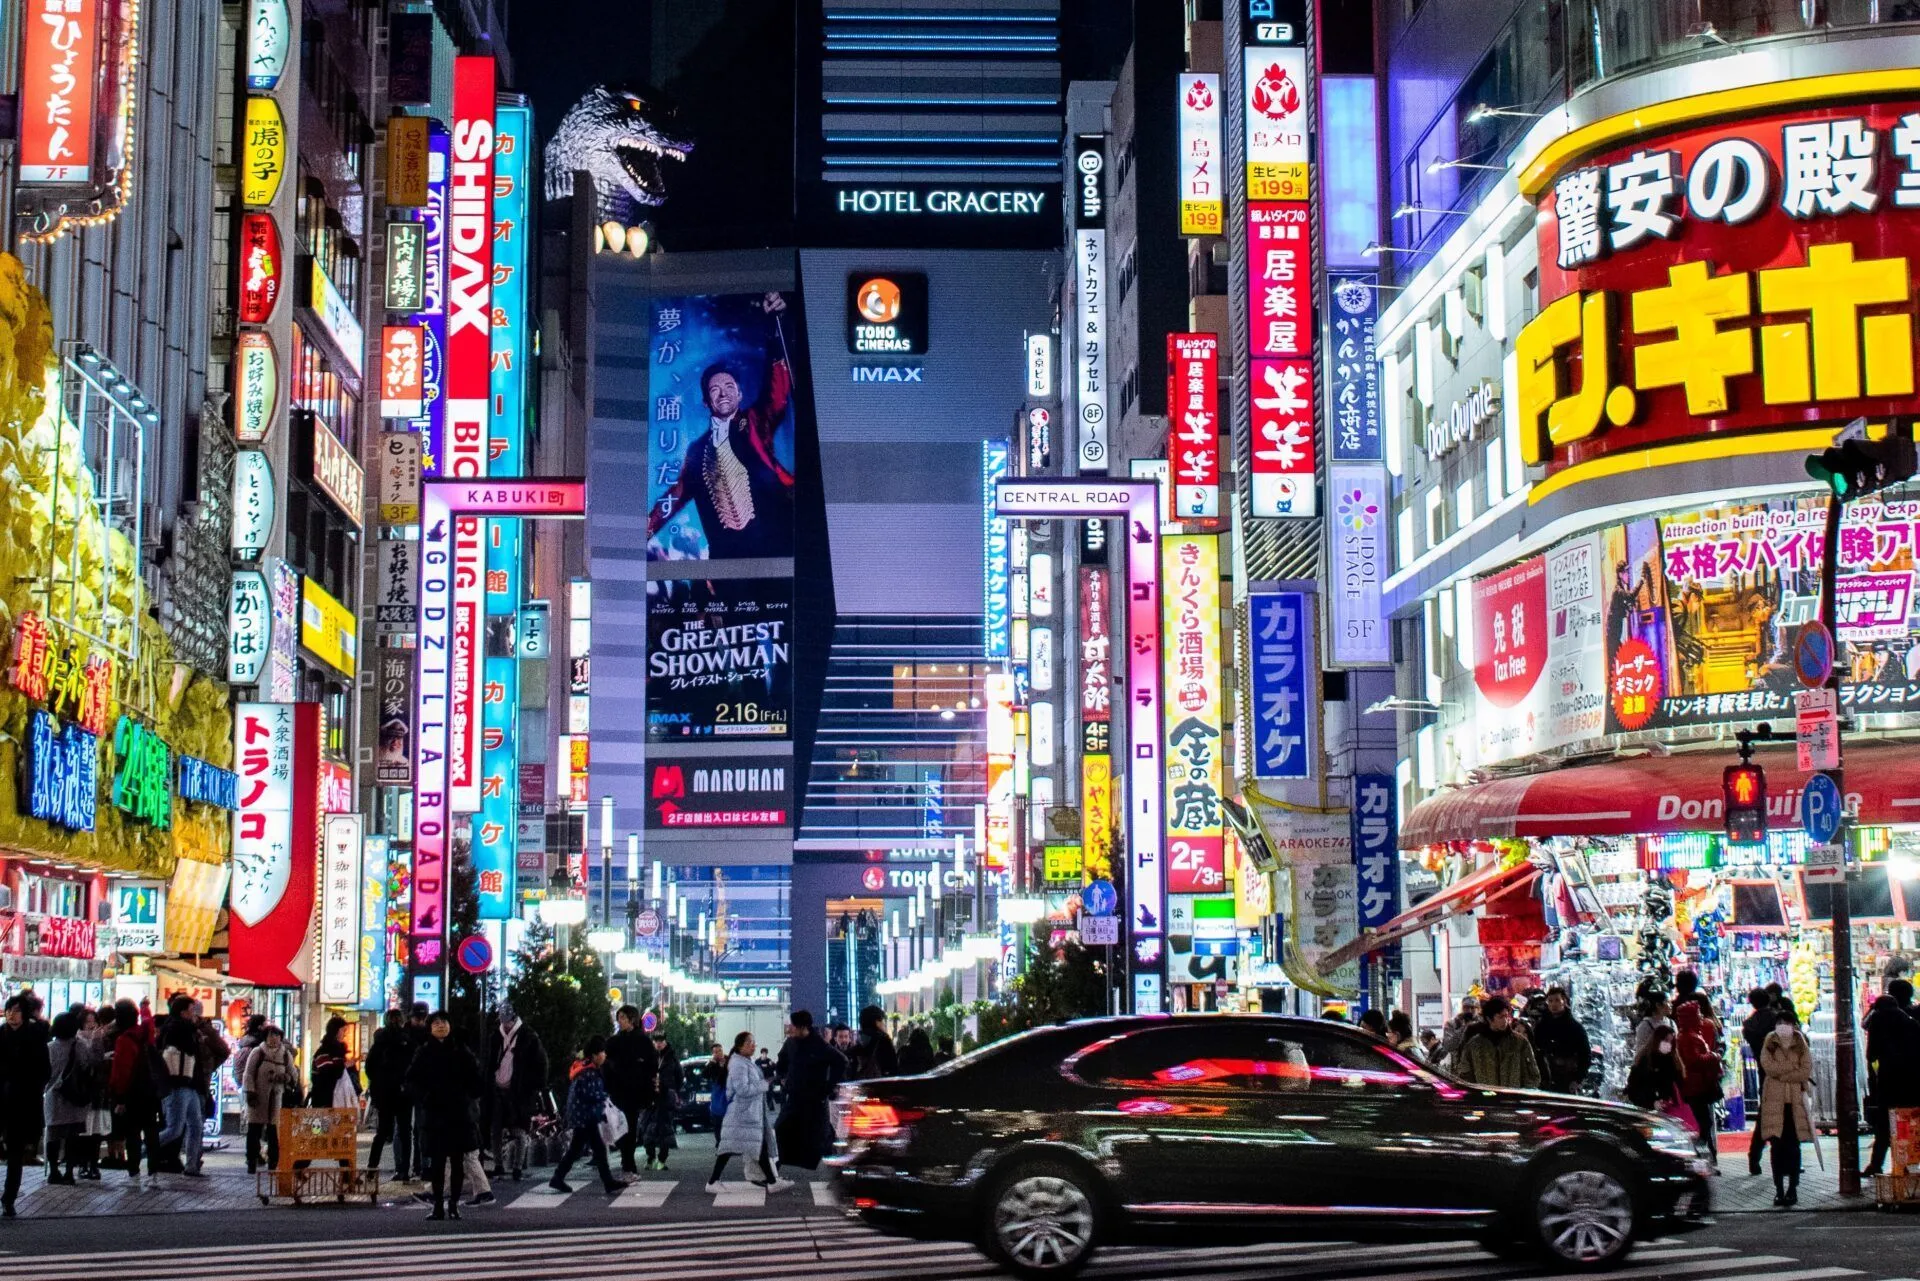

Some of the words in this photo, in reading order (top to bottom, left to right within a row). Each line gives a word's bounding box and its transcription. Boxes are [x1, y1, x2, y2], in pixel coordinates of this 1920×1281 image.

[1262, 27, 1289, 38] 7F
[41, 13, 83, 161] ひょうたん
[254, 76, 271, 86] 5F
[1253, 131, 1301, 147] 鳥メロ
[250, 128, 279, 181] 虎の子
[1191, 138, 1210, 195] 鳥メロ
[45, 168, 69, 179] 7F
[1253, 166, 1302, 177] 生ビール
[247, 190, 267, 201] 4F
[838, 190, 922, 213] HOTEL
[926, 191, 1045, 214] GRACERY
[1554, 112, 1920, 270] 驚安の殿
[1184, 203, 1217, 211] 生ビール
[450, 119, 494, 337] SHIDAX
[1085, 237, 1099, 314] ネットカフェ
[398, 298, 412, 307] 5F
[1262, 249, 1299, 353] 居楽屋
[855, 339, 911, 351] CINEMAS
[856, 326, 896, 339] TOHO
[852, 366, 923, 382] IMAX
[1085, 340, 1099, 393] カプセル
[245, 351, 265, 430] お好み焼き
[656, 308, 682, 535] 夢が、踊りだす。
[1427, 421, 1449, 462] Don
[1451, 377, 1499, 441] Quijote
[453, 421, 481, 477] BIC
[1004, 492, 1080, 503] CENTRAL
[1086, 492, 1130, 503] ROAD
[389, 506, 410, 520] 3F
[1665, 520, 1727, 538] Attraction
[1732, 514, 1765, 529] built
[1768, 512, 1792, 526] for
[1797, 513, 1806, 522] a
[1813, 505, 1848, 520] rel
[1851, 505, 1879, 522] spy
[238, 548, 258, 560] 1F
[456, 517, 479, 589] RUG
[1361, 536, 1375, 587] IDOL
[1666, 520, 1920, 580] 本格スパイ体験ア
[1345, 535, 1361, 599] STAGE
[235, 580, 259, 591] 新宿
[234, 592, 260, 656] かっぱ
[456, 607, 470, 628] BIC
[683, 620, 705, 630] THE
[1178, 543, 1206, 680] きんくら酒場
[660, 620, 785, 652] GREATEST
[1347, 619, 1375, 639] 5F
[1493, 601, 1525, 655] 免税
[234, 662, 255, 675] B1
[421, 550, 448, 765] GODZILLA
[649, 642, 790, 678] SHOWMAN
[1494, 659, 1508, 683] Tax
[1508, 655, 1527, 679] Free
[1614, 653, 1655, 676] レーザー
[669, 668, 771, 691] グレイテスト・ショーマン
[1082, 635, 1110, 711] 甘太郎
[1259, 600, 1301, 770] カラオケ
[1614, 675, 1655, 695] ギミック
[650, 712, 691, 724] IMAX
[715, 702, 758, 723] 2.16
[1622, 695, 1646, 715] 追加
[272, 707, 292, 781] 大衆酒場
[1085, 722, 1109, 736] 4F
[1085, 737, 1109, 751] 3F
[240, 716, 271, 840] トラノコ
[480, 681, 506, 894] カラオケ館
[693, 768, 785, 793] MARUHAN
[1169, 716, 1221, 831] 金の蔵
[1657, 795, 1722, 821] Don
[1808, 791, 1824, 834] P
[1820, 815, 1832, 833] 40
[418, 791, 443, 894] ROAD
[1170, 841, 1206, 871] 2F
[1359, 782, 1392, 920] カラオケ
[519, 858, 540, 867] 729
